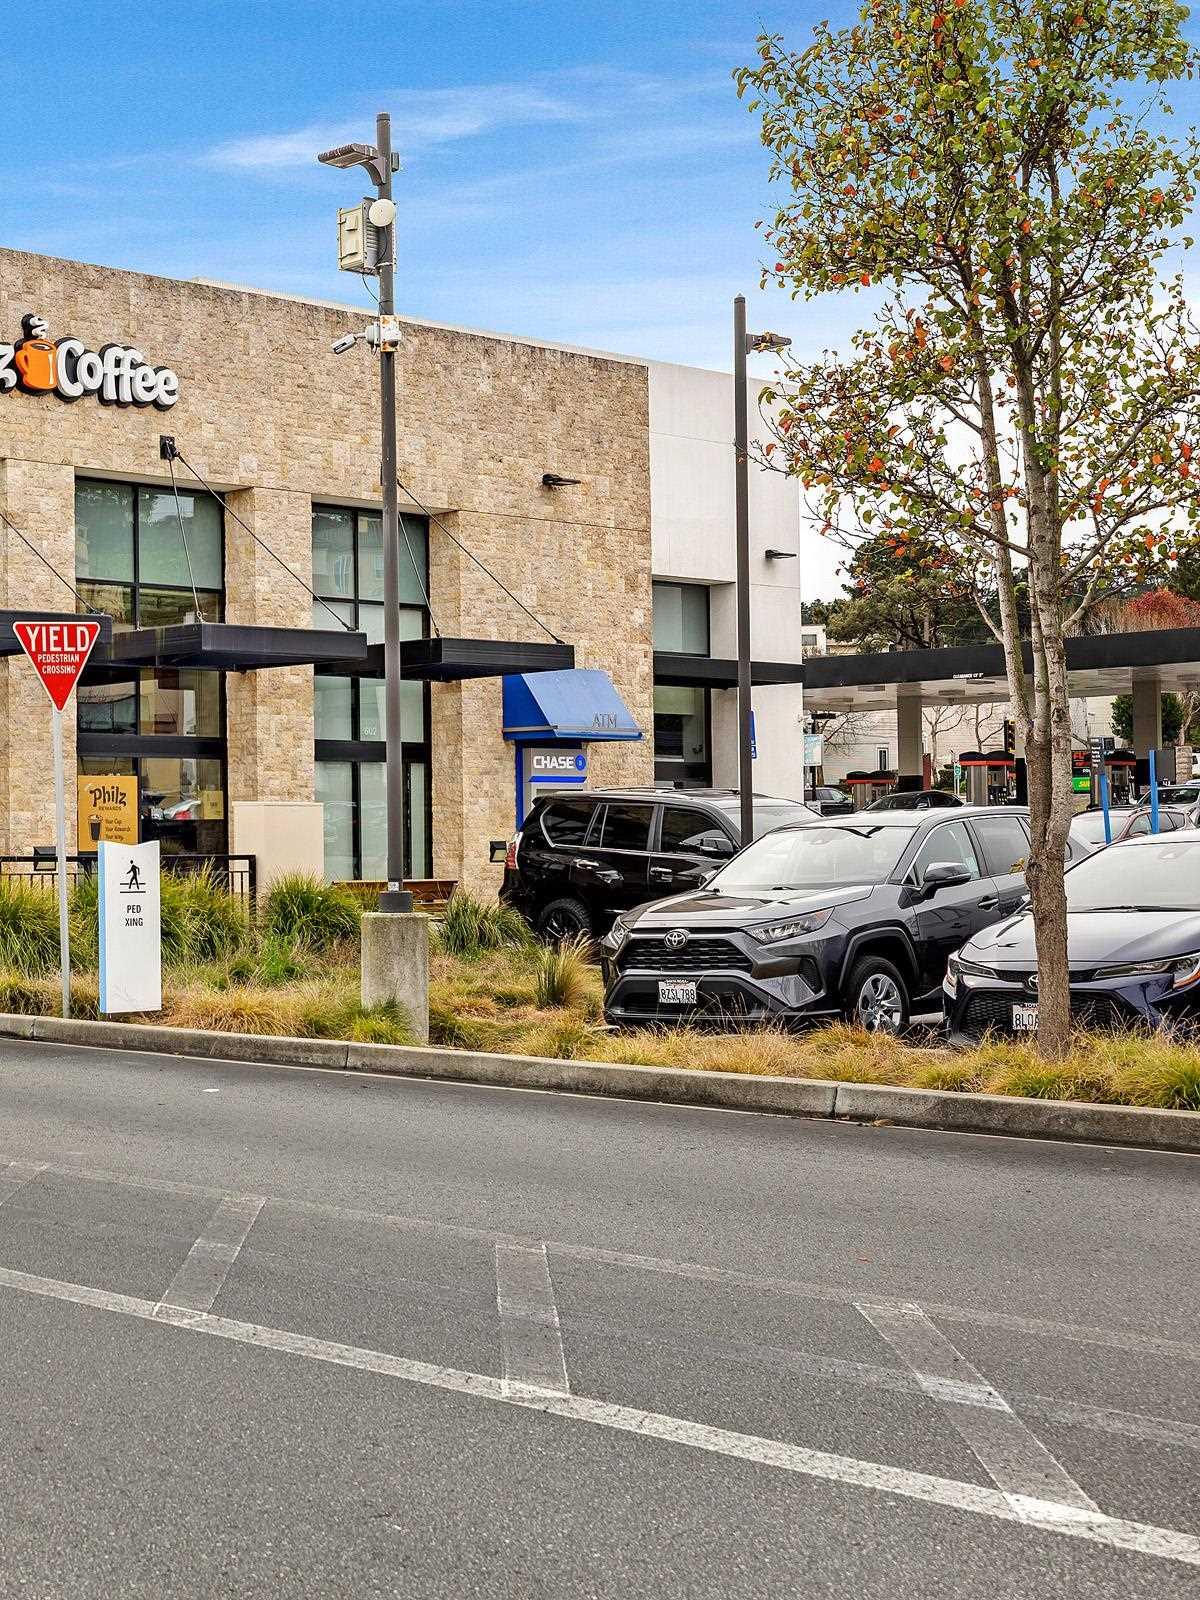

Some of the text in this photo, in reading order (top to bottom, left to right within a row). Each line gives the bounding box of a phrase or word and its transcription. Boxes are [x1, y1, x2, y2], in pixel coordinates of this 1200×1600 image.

[54, 338, 180, 409] Coffee
[25, 625, 90, 652] YIELD
[37, 653, 80, 663] PEDESTRIAN
[42, 665, 76, 674] CROSSING
[592, 713, 617, 728] ATM
[533, 756, 576, 769] CHASE
[89, 786, 127, 807] Philz
[126, 904, 142, 914] PED
[125, 917, 144, 927] XING
